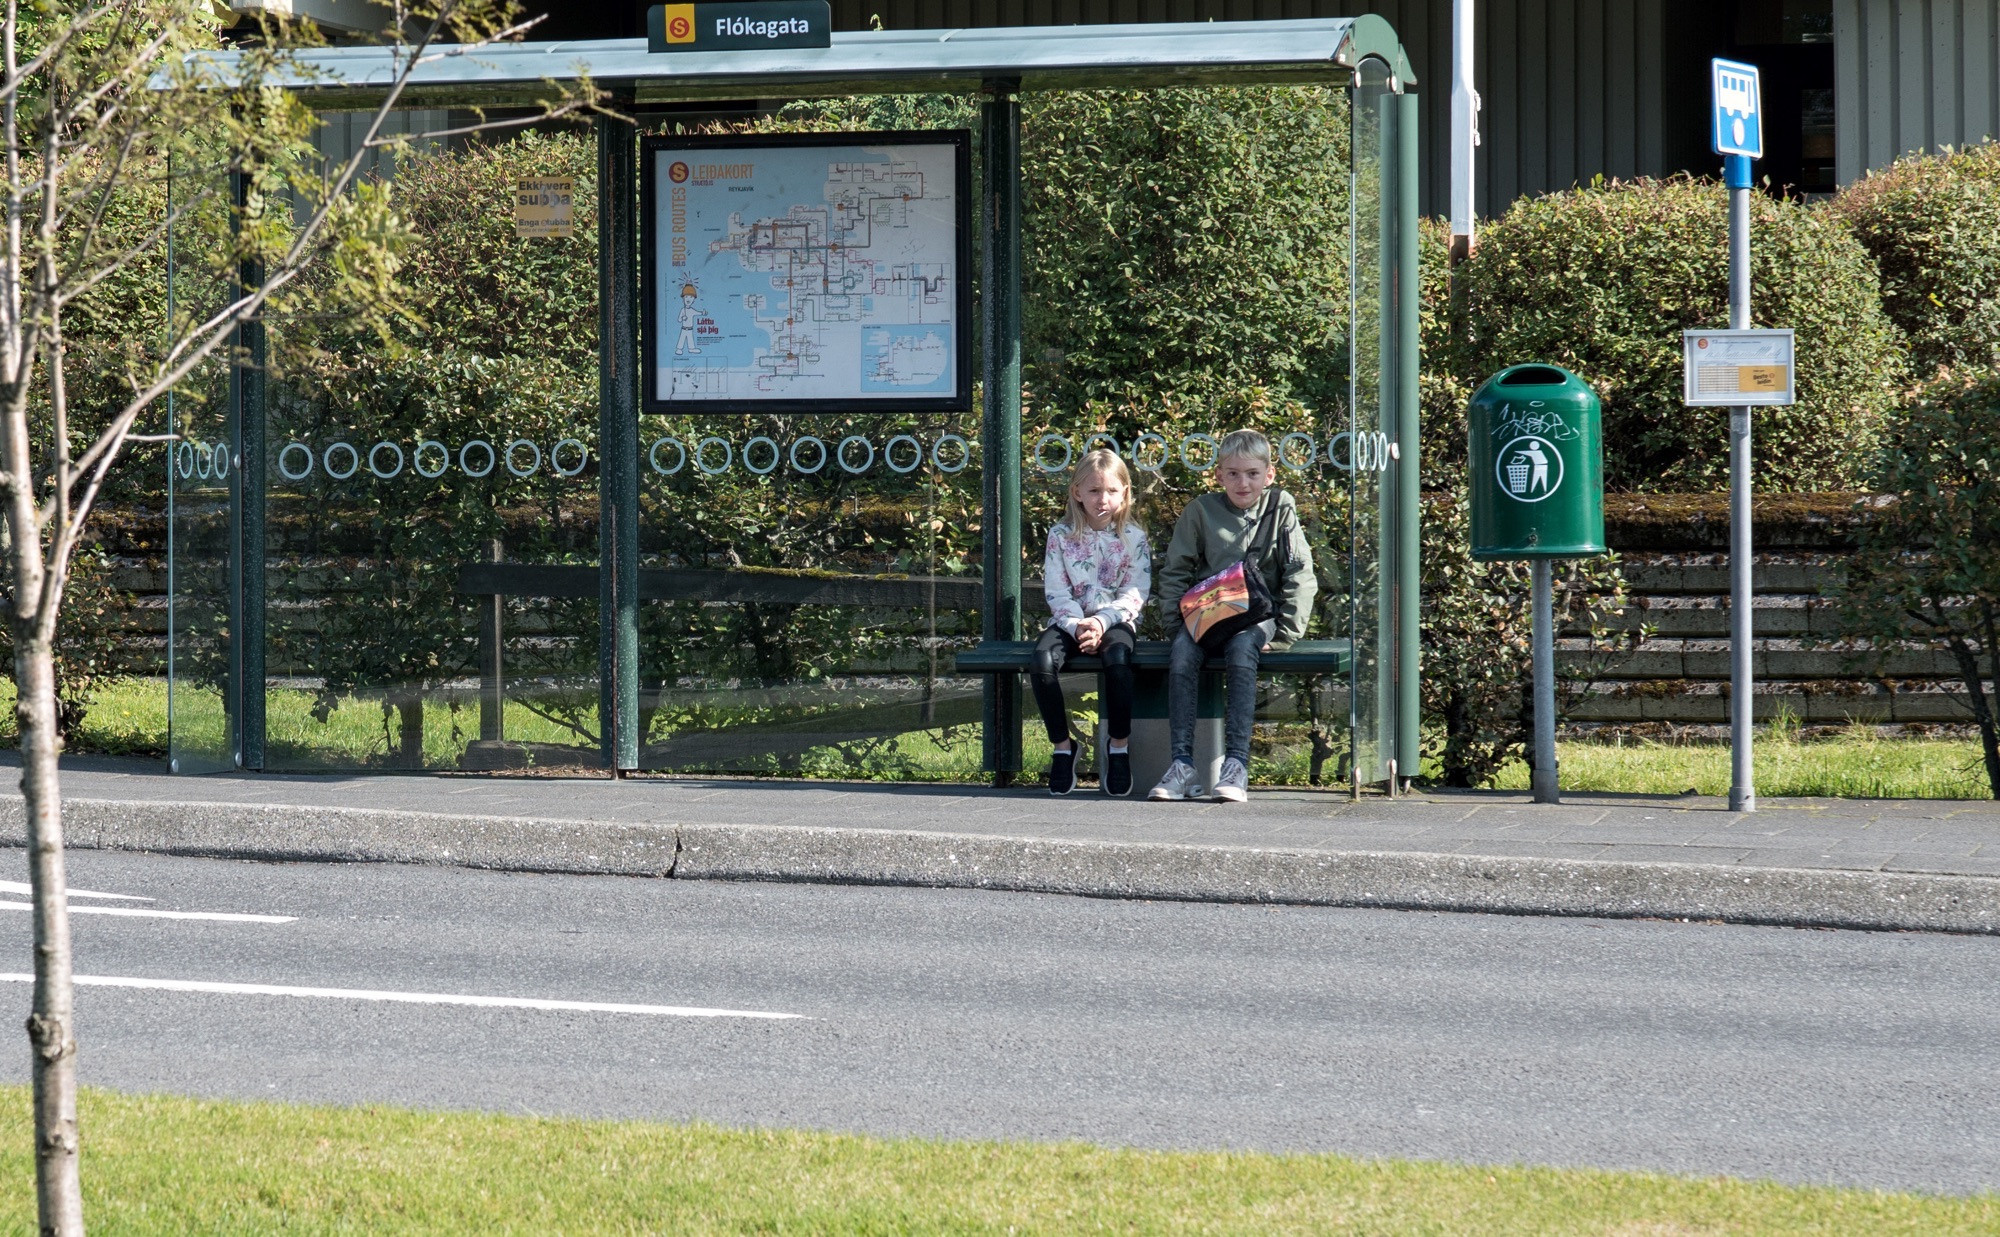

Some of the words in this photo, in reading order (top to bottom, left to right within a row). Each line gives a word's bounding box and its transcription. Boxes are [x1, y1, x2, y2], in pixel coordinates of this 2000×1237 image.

[672, 18, 688, 37] S
[716, 17, 809, 38] Flókagata
[546, 182, 571, 190] vera
[672, 187, 687, 233] ROUTES
[518, 219, 540, 227] Enga
[672, 236, 687, 261] BUS
